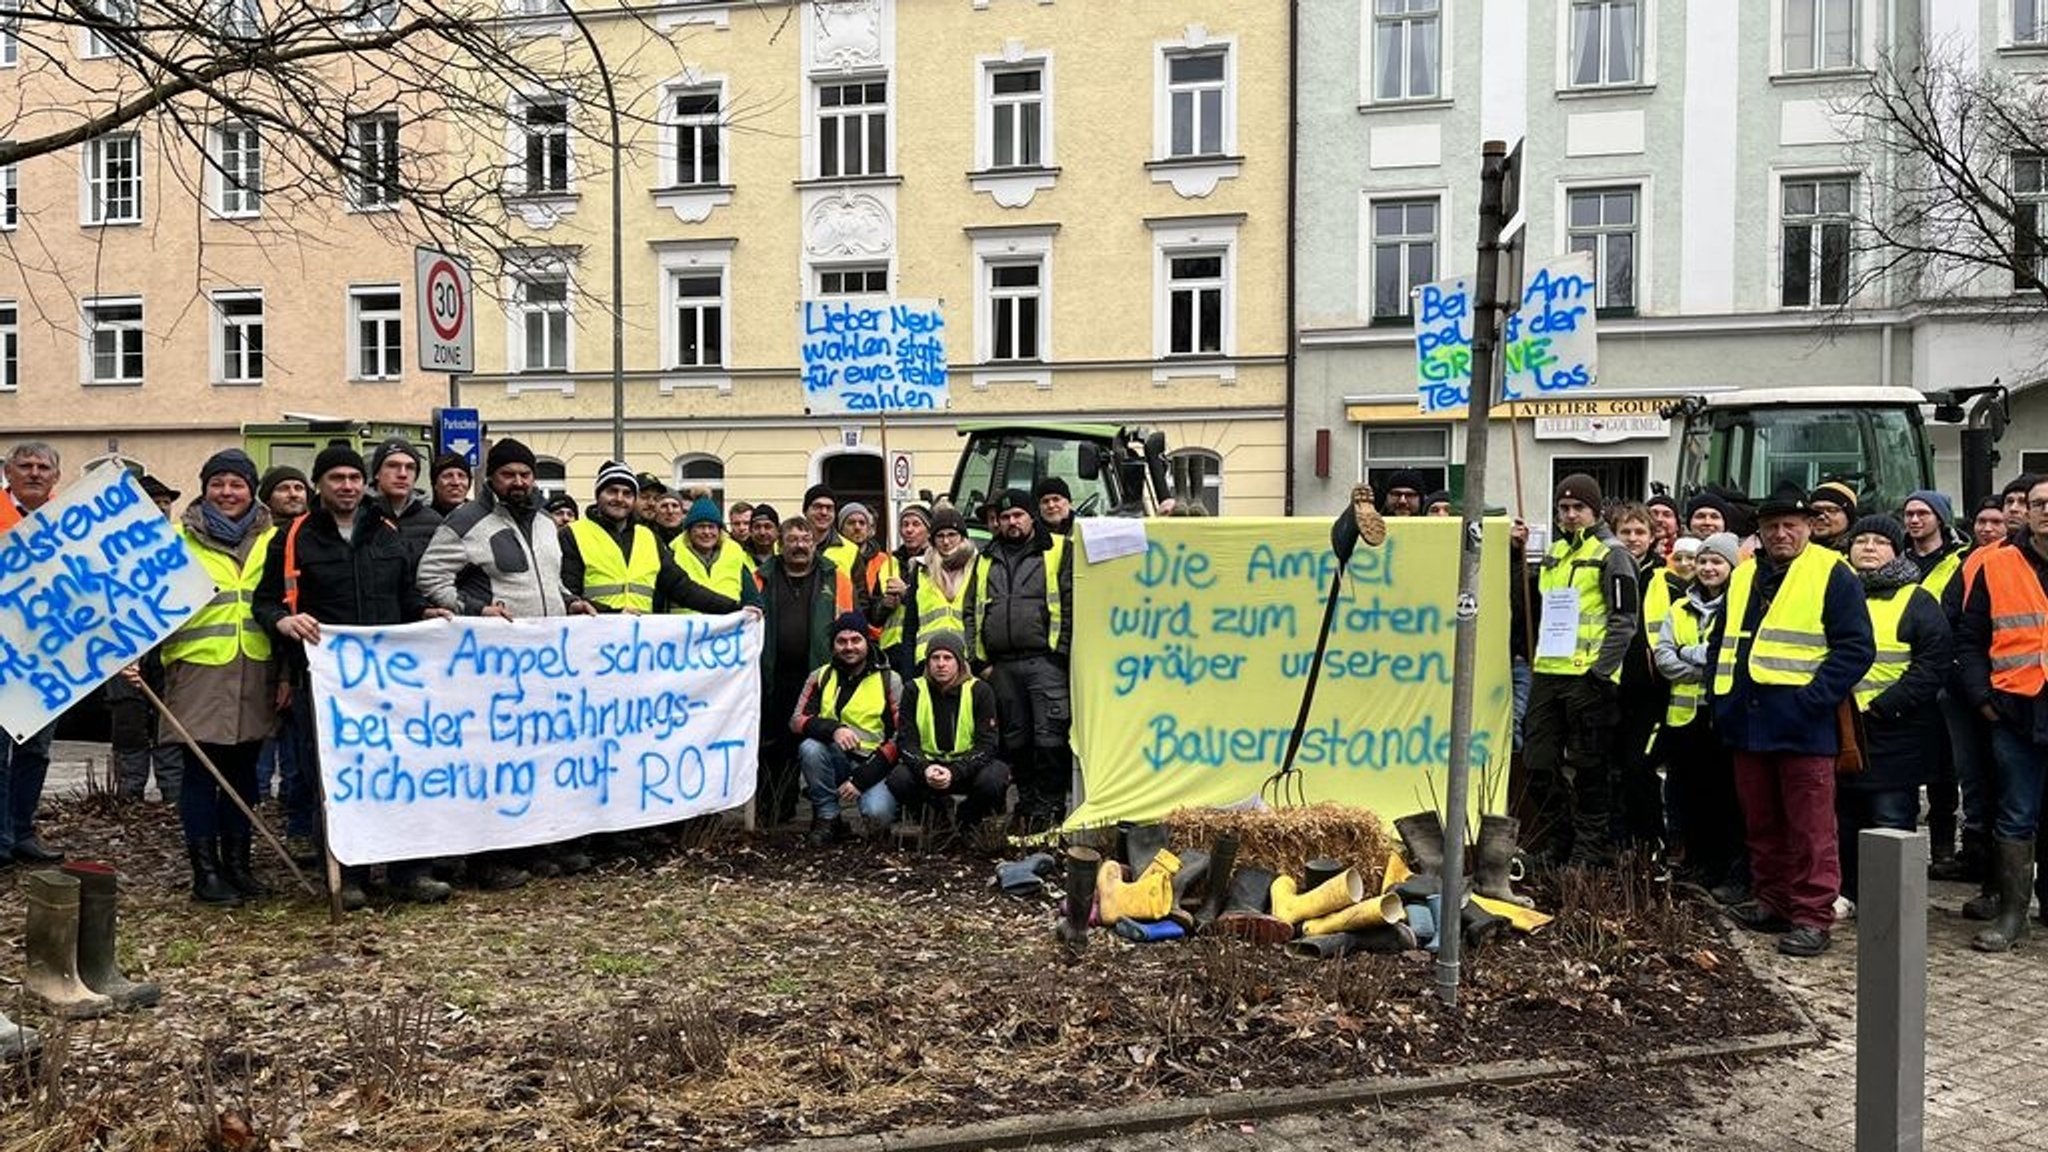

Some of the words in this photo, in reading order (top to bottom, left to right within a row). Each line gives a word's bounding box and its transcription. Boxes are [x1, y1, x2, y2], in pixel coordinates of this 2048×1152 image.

[434, 281, 457, 319] 30
[805, 301, 882, 336] Lieber
[1421, 281, 1466, 324] Bei
[802, 332, 892, 363] wahlen
[1417, 319, 1473, 360] pel
[1529, 302, 1587, 333] der
[433, 344, 462, 366] ZONE
[801, 363, 839, 392] für
[840, 383, 934, 411] zahlen
[1520, 401, 1599, 416] ATELIER
[0, 467, 140, 580] elsteuer
[1134, 541, 1218, 588] Die
[1246, 536, 1396, 591] Ampel
[39, 605, 106, 655] die
[1109, 597, 1199, 640] wird
[1211, 603, 1297, 638] zum
[29, 584, 191, 713] BLANK
[328, 629, 425, 690] Die
[446, 626, 581, 694] Ampel
[594, 619, 749, 677] schaltet
[1113, 643, 1248, 697] gräber
[1280, 645, 1453, 684] unseren
[328, 695, 394, 752] bei
[403, 697, 475, 750] der
[488, 688, 709, 747] Ernährungs-
[331, 752, 537, 818] sicherung
[553, 737, 619, 806] auf
[638, 739, 747, 812] ROT
